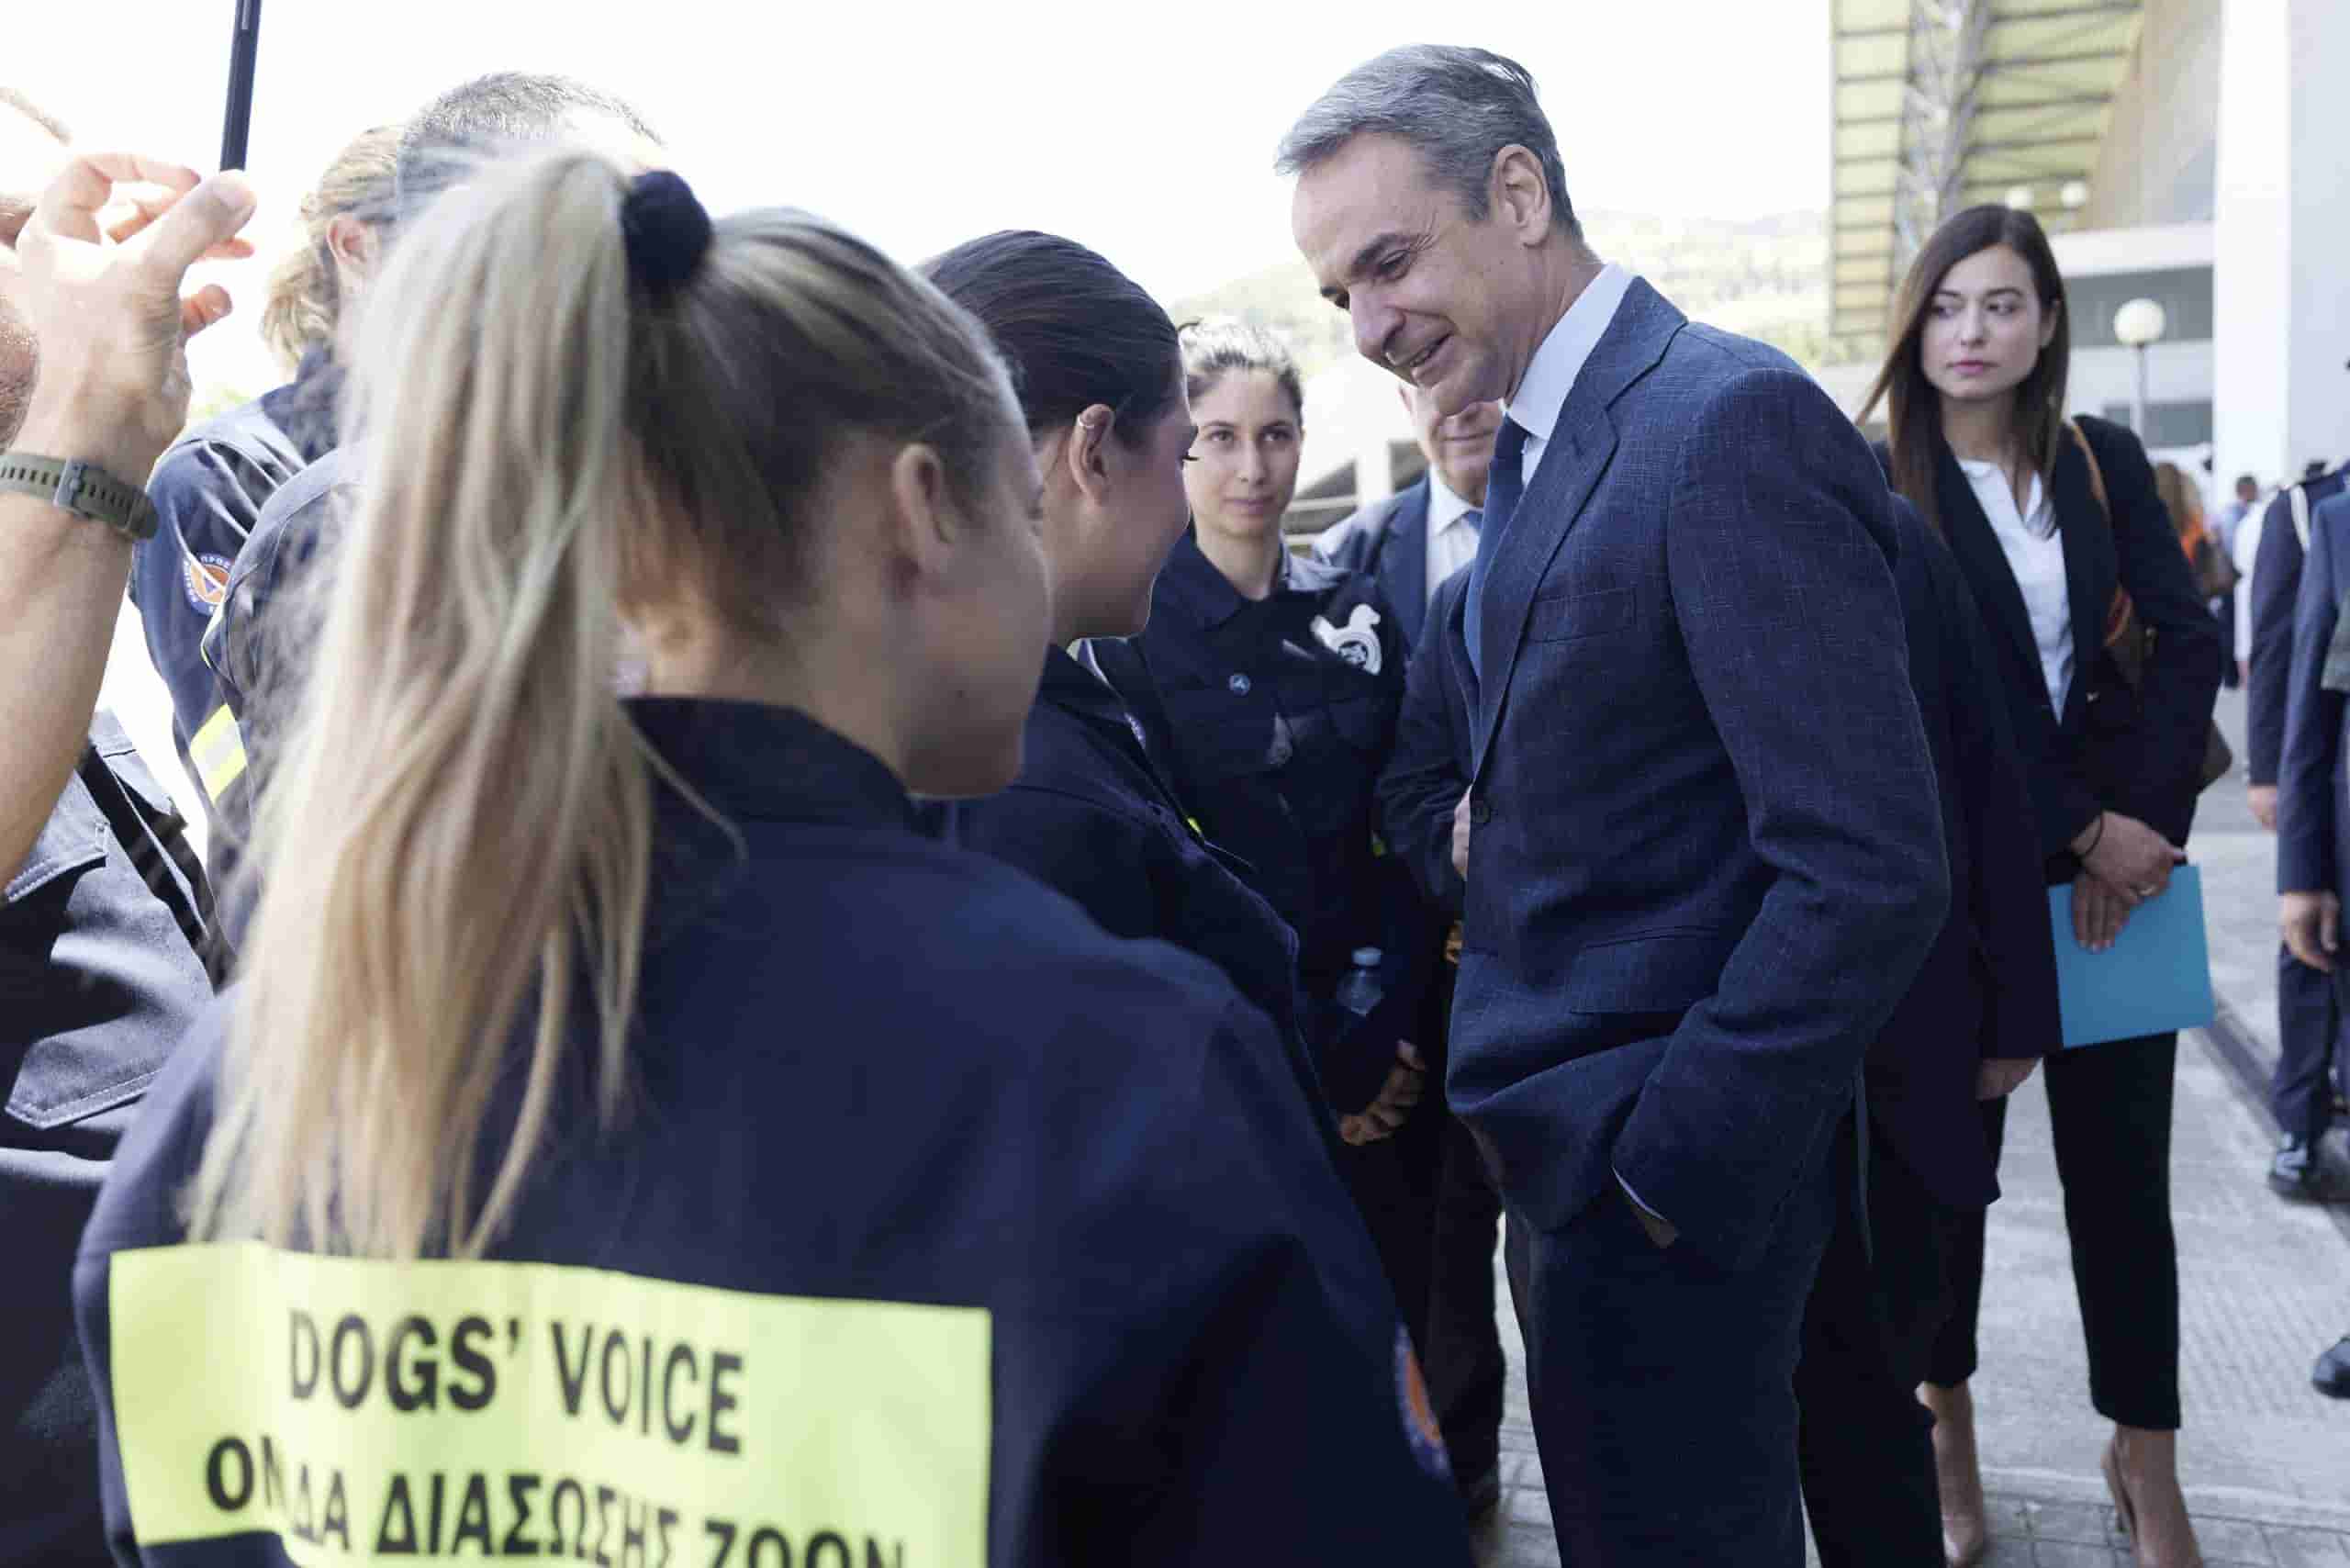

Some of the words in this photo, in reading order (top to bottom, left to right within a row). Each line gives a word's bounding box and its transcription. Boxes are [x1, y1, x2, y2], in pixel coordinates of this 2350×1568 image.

[289, 1310, 520, 1413] DOGS'
[550, 1320, 744, 1455] VOICE
[206, 1435, 352, 1553] ΟΜΔΑ
[375, 1472, 680, 1568] ΔΙΑΣΩΣΗΣ
